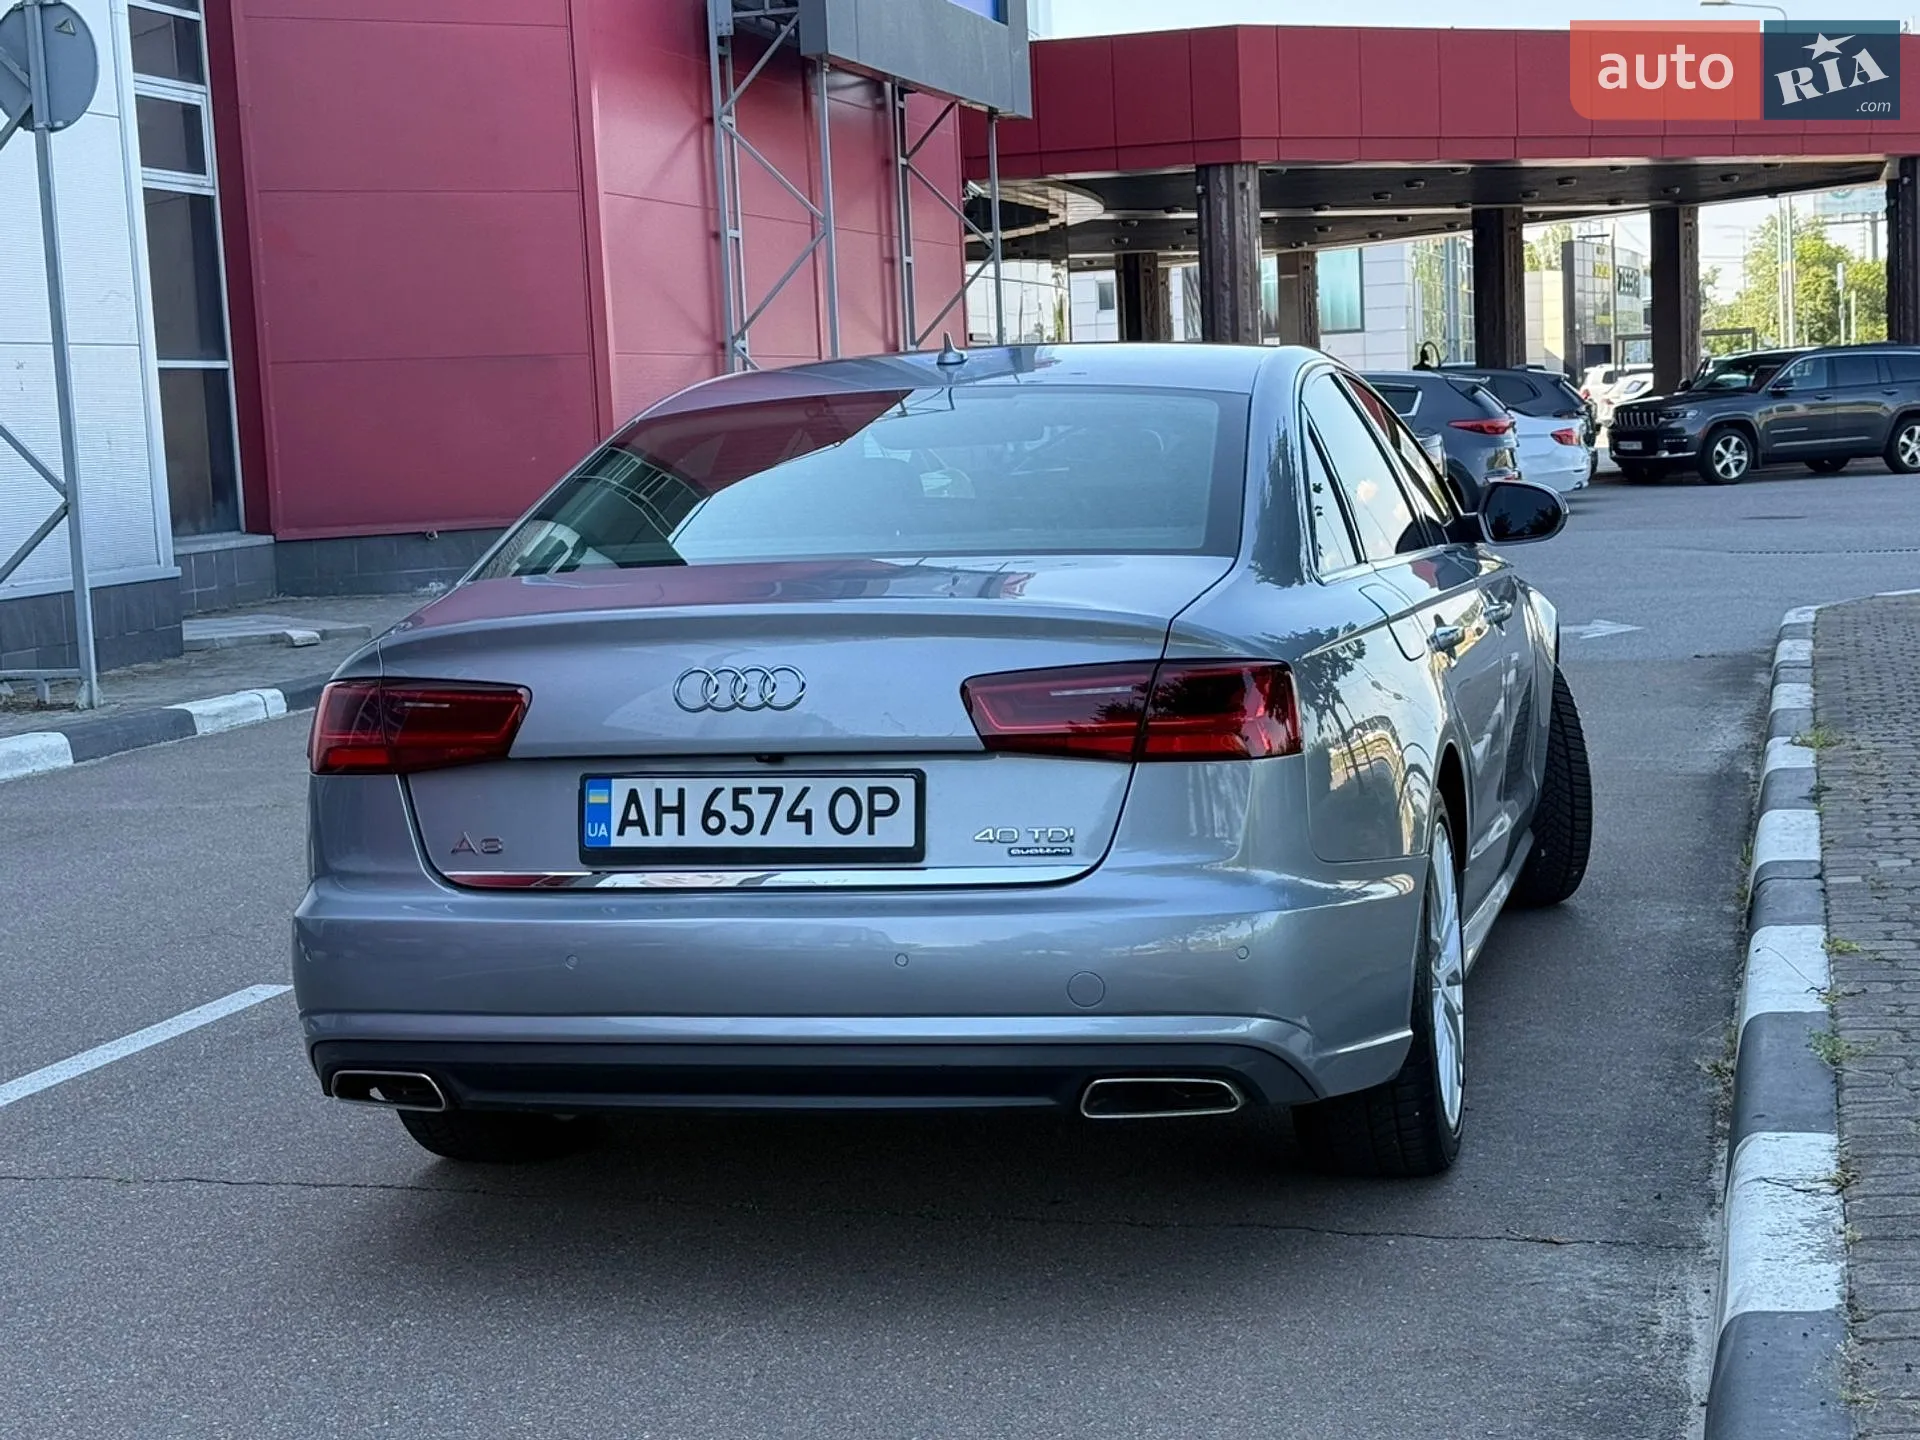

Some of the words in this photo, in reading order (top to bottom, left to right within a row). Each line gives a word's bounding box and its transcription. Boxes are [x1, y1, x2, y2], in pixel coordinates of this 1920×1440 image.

[616, 787, 686, 837] AH
[701, 786, 813, 836] 6574
[828, 786, 901, 836] OP
[587, 824, 609, 838] UA
[974, 827, 1019, 843] 40
[1026, 827, 1075, 843] TDI
[450, 831, 503, 856] A6
[1009, 847, 1072, 856] quattro
